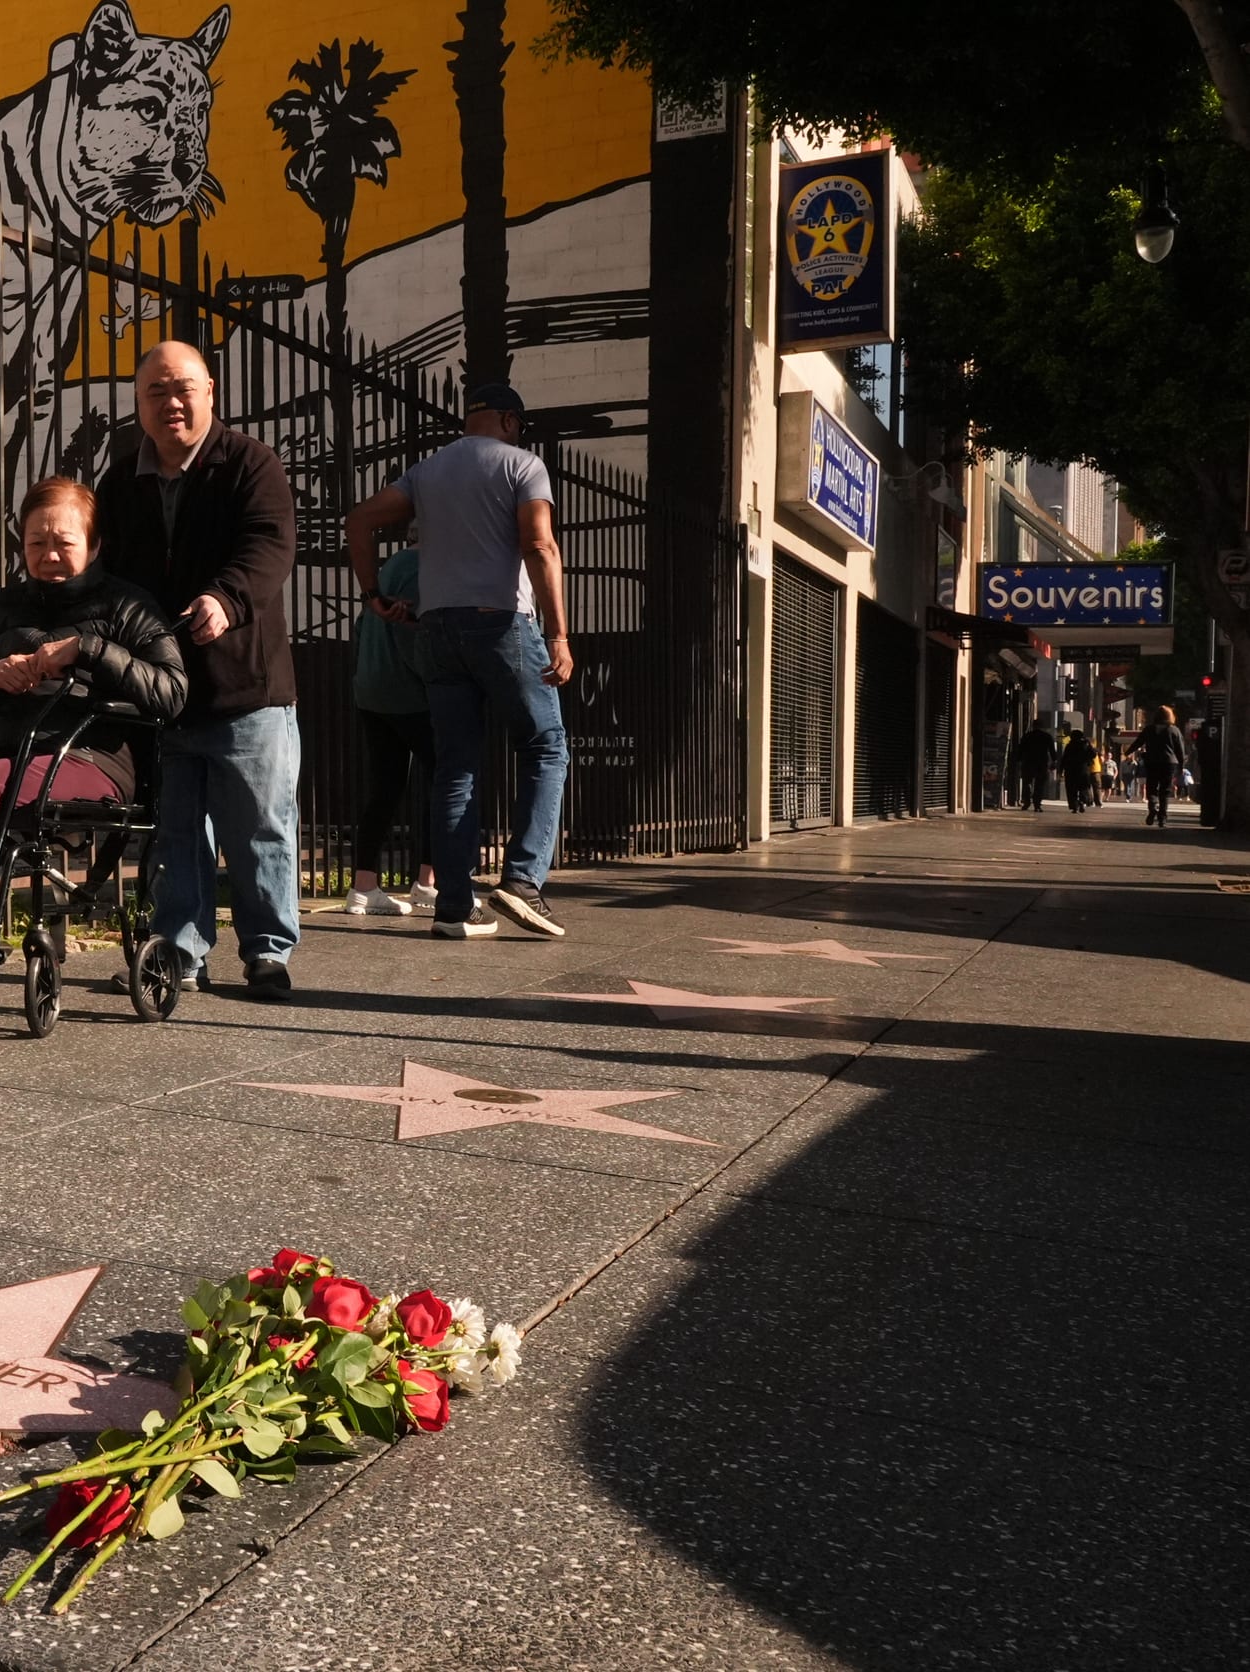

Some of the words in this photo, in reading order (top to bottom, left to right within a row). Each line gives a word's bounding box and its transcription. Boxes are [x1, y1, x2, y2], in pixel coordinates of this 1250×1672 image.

[795, 180, 867, 216] HOLLYWOOD
[807, 213, 853, 230] LAPD
[823, 227, 835, 242] 6
[796, 257, 822, 271] POLICE
[824, 254, 863, 264] ACTIVITIES
[814, 267, 845, 276] LEAGUE
[810, 280, 848, 297] PAL
[824, 459, 848, 506] MARTIAL
[849, 484, 863, 517] ARTS
[987, 575, 1164, 610] Souvenirs
